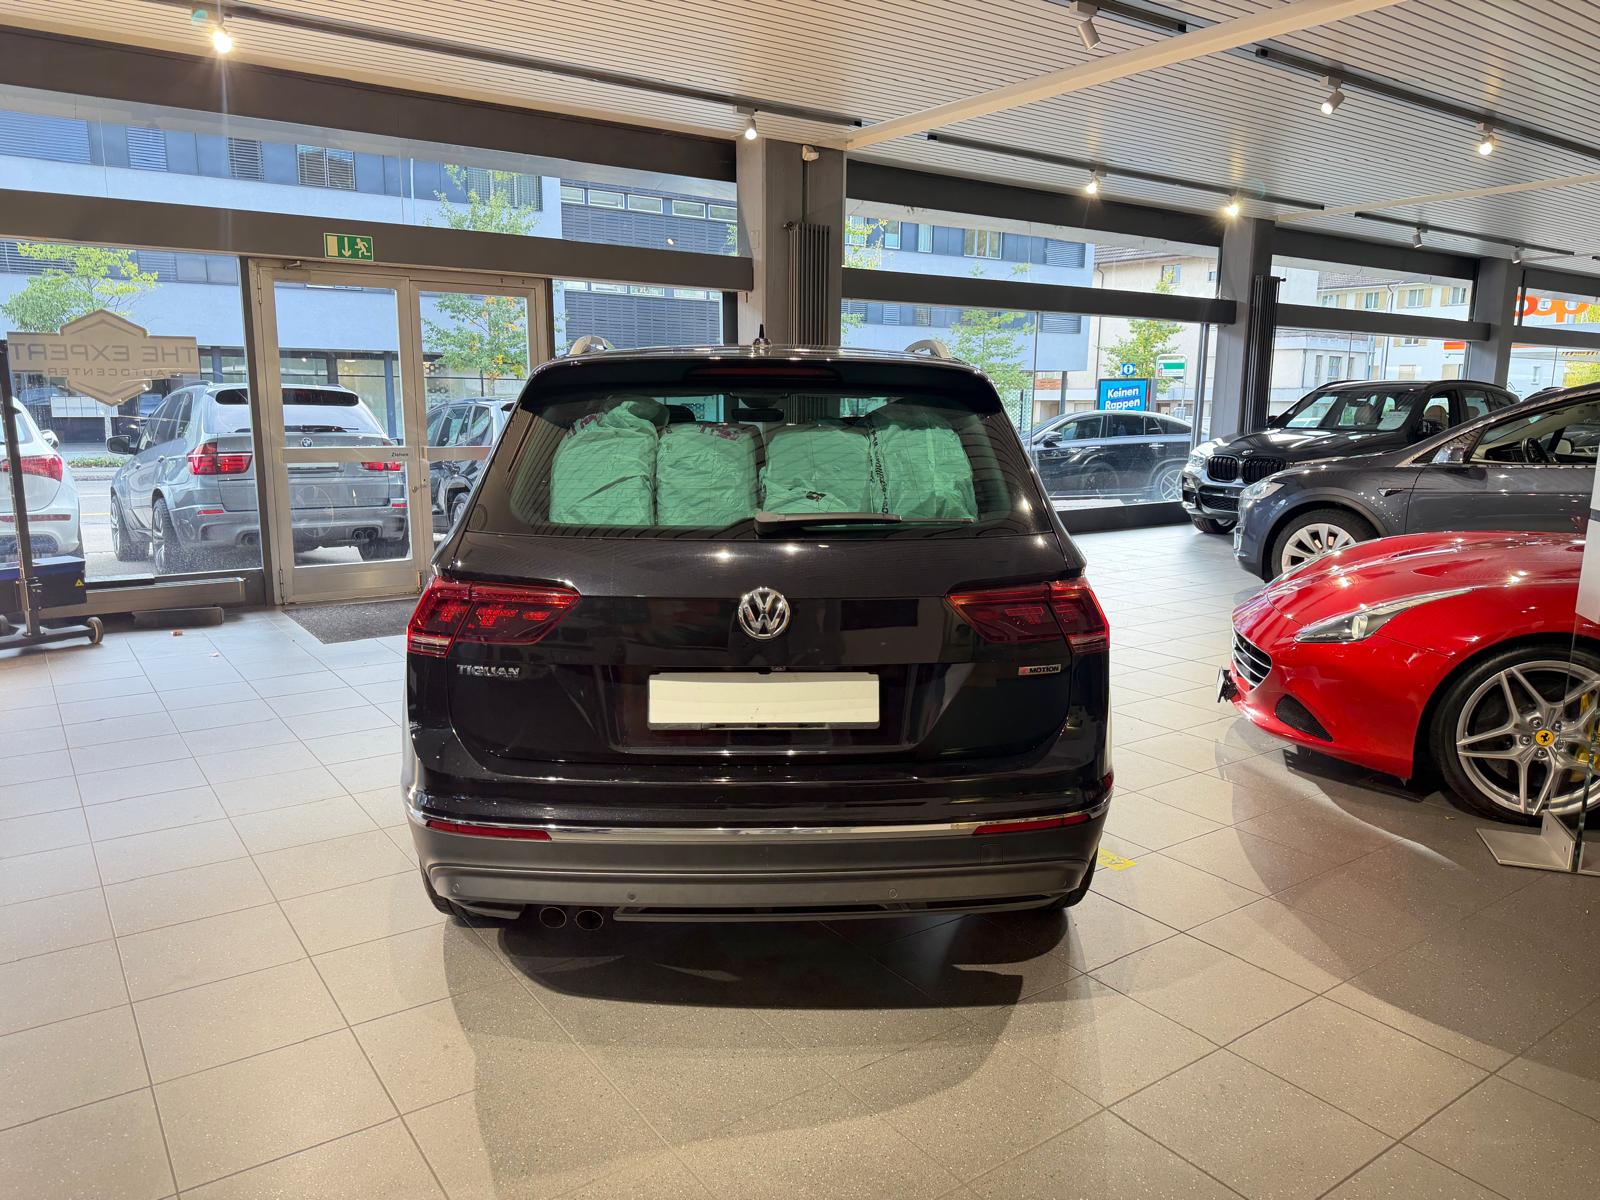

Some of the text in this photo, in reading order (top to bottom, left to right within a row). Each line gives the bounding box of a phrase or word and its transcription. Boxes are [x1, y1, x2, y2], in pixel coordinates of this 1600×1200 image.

[1107, 387, 1139, 399] Keinen
[1105, 398, 1141, 410] Rappen
[456, 664, 520, 678] TIGUAN
